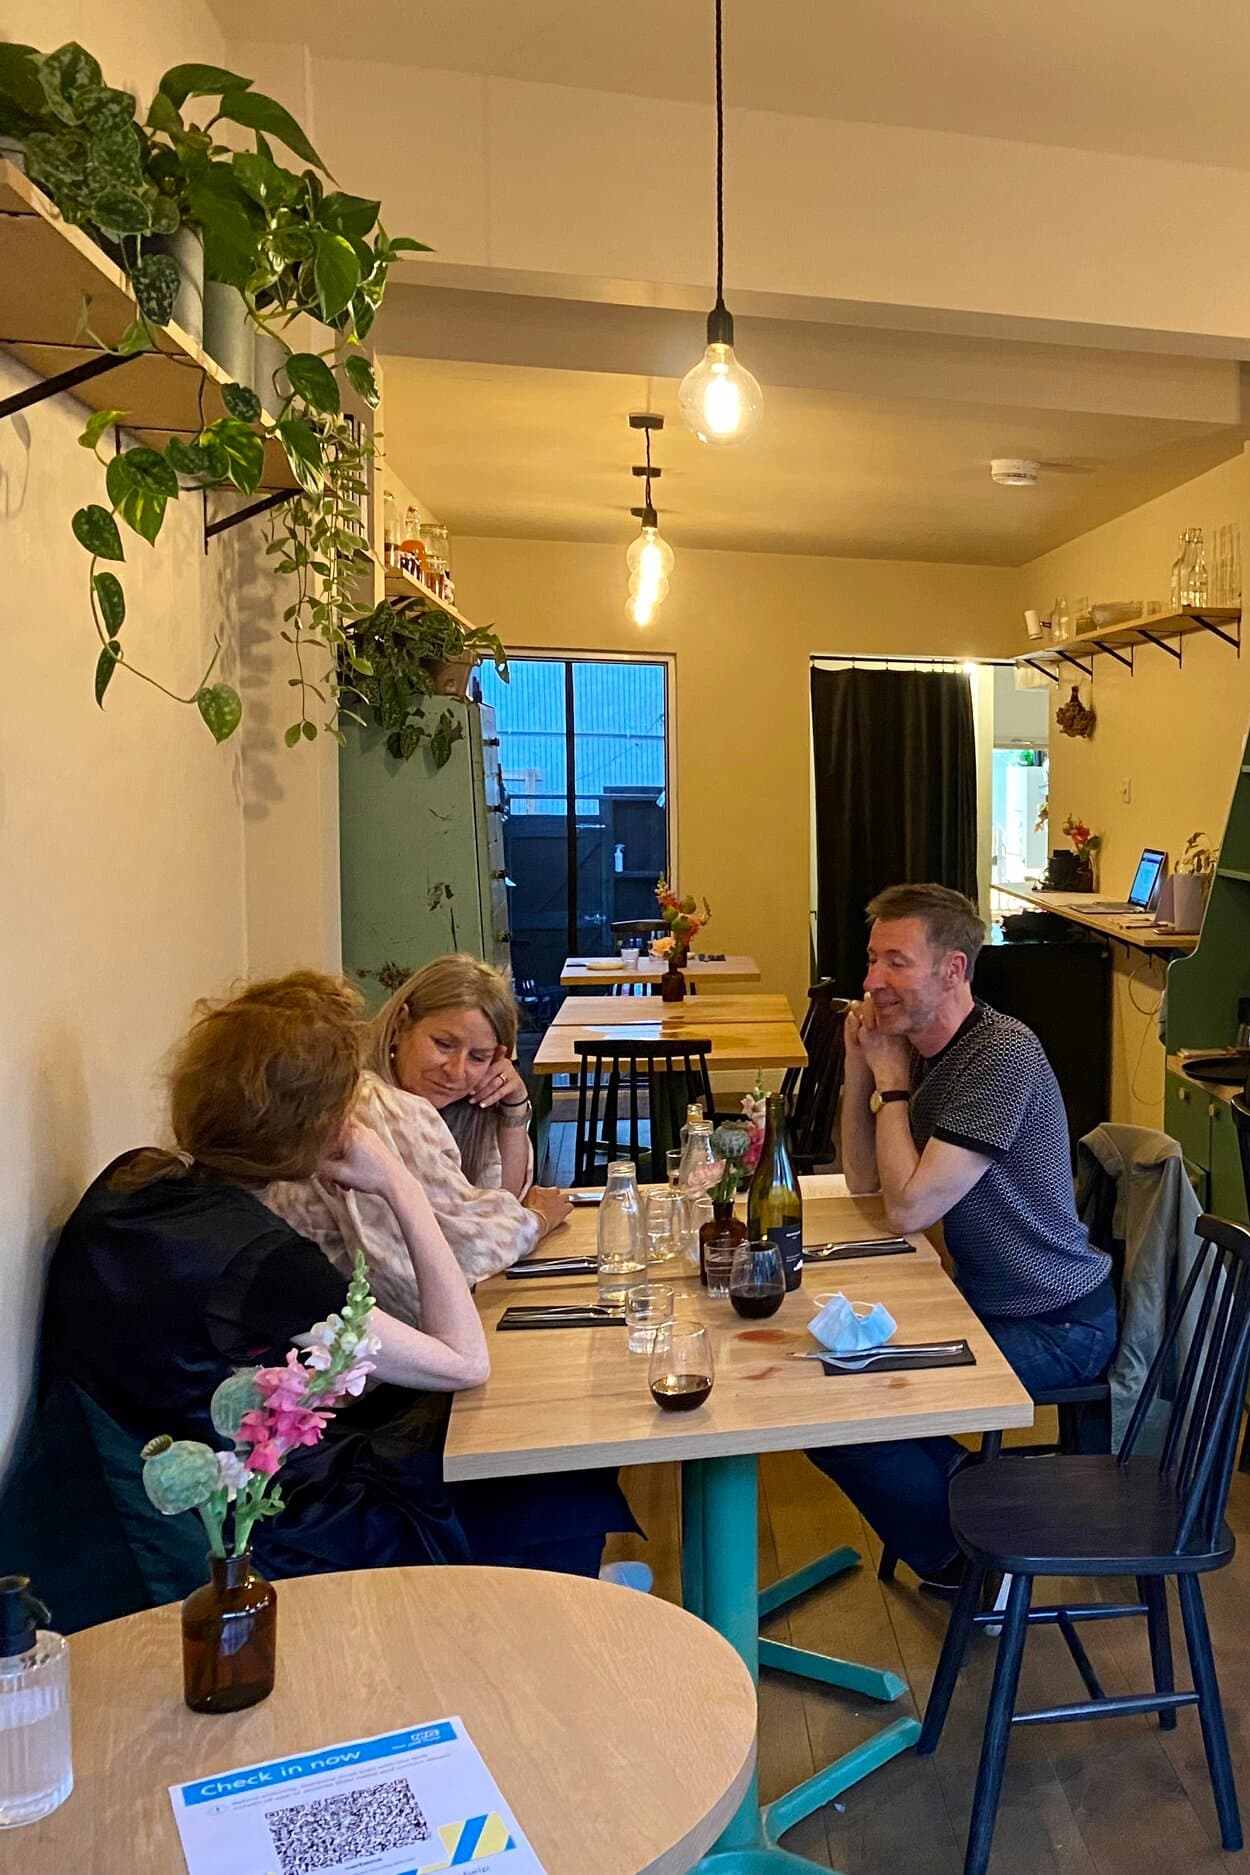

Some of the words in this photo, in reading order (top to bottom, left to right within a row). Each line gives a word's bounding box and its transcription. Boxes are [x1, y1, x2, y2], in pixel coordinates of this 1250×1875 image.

[200, 1772, 273, 1796] Check
[280, 1765, 303, 1777] in
[310, 1751, 361, 1770] now
